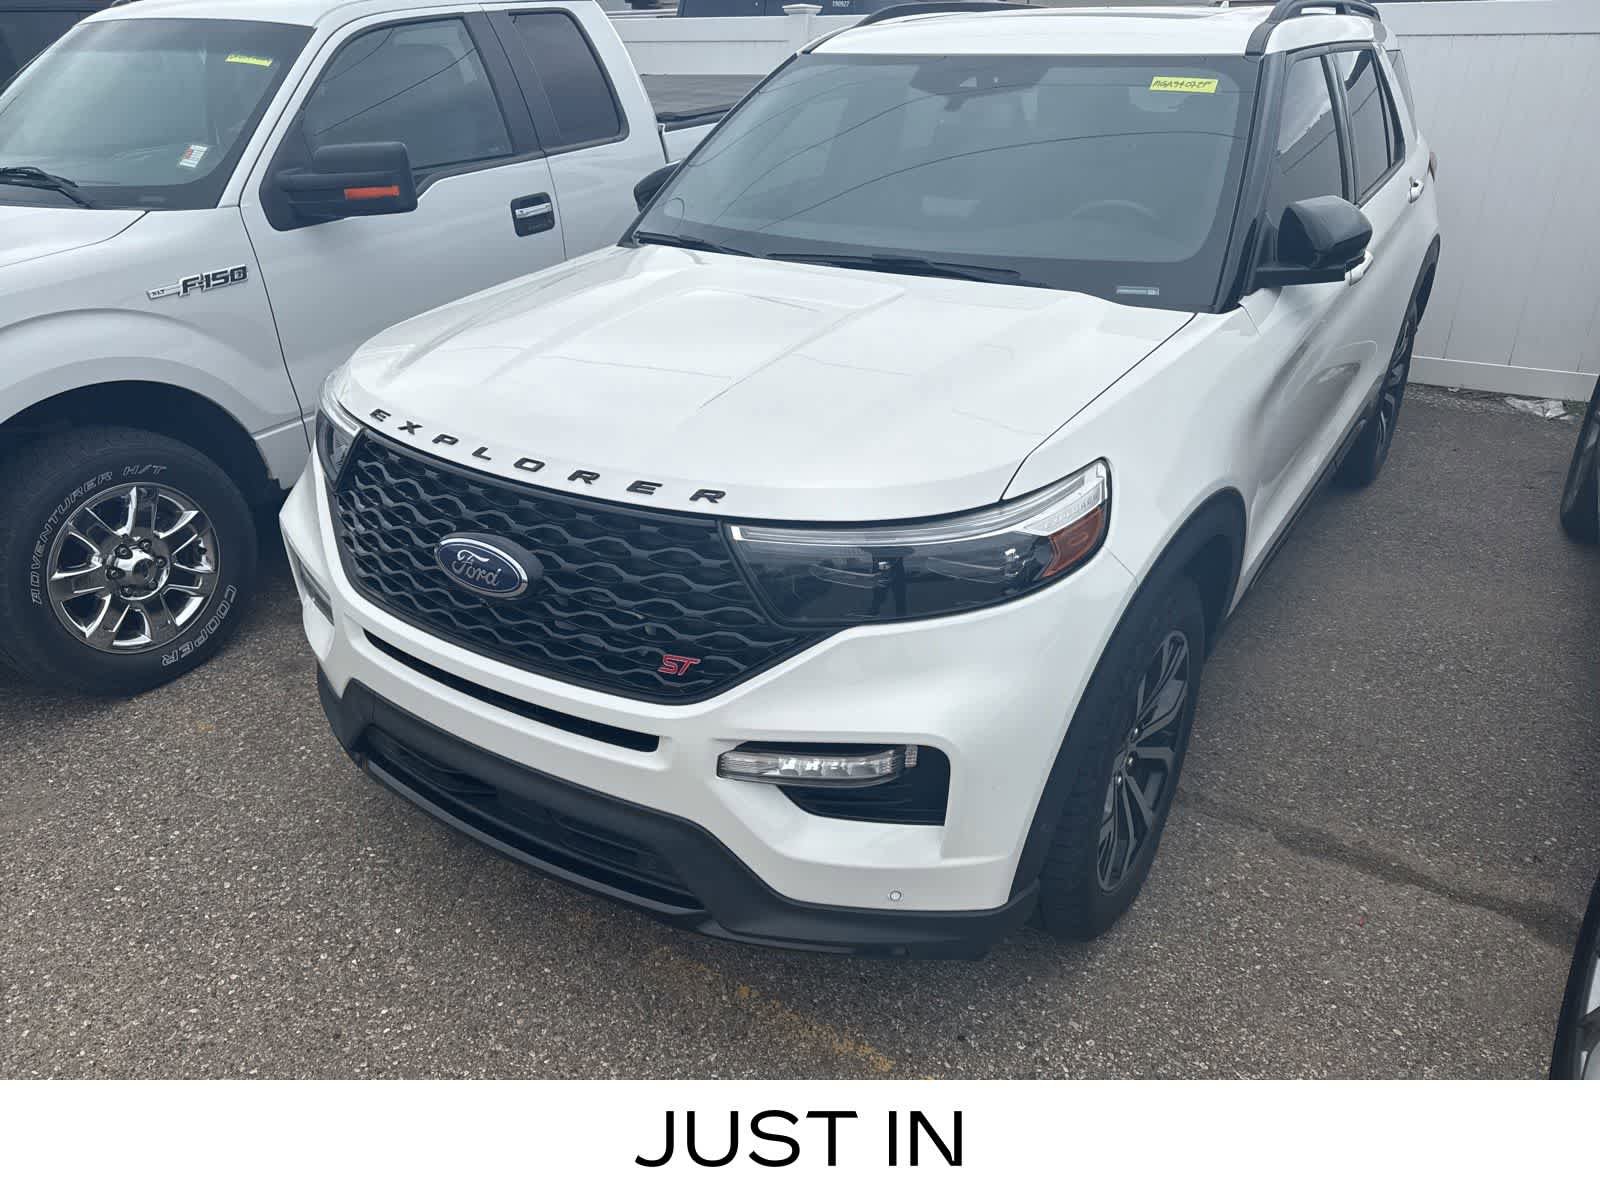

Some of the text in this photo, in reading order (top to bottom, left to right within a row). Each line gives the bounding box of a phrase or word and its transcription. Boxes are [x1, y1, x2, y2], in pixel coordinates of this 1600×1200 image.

[181, 264, 248, 296] F-150
[369, 408, 727, 504] EXPLORER
[31, 471, 113, 606] ADVENTURER
[451, 548, 502, 588] Ford
[161, 584, 237, 667] COOPER
[658, 653, 701, 677] ST
